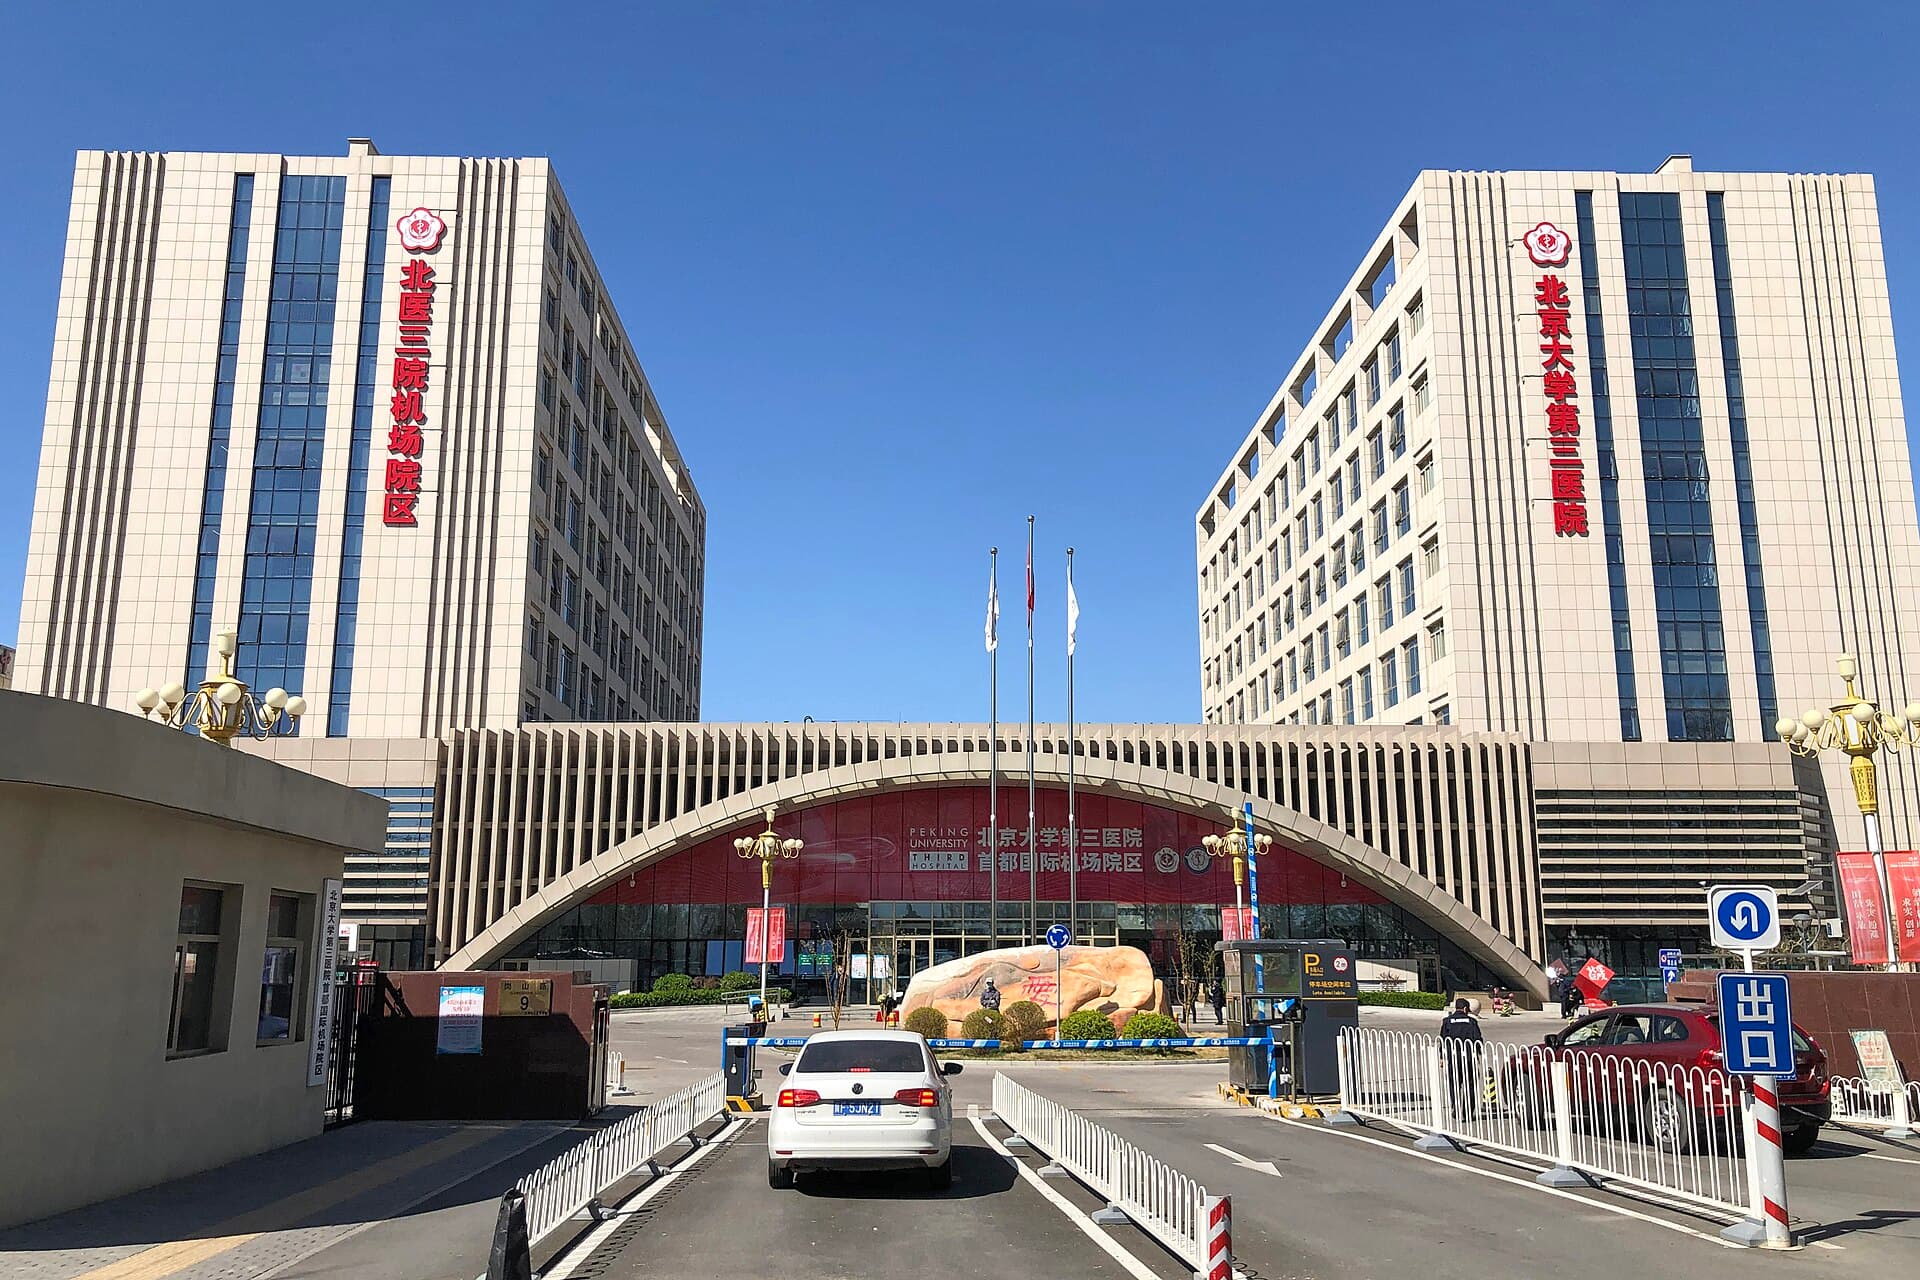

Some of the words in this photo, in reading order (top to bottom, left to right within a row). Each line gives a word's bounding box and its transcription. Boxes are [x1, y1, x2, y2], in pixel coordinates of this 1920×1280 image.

[383, 259, 433, 525] 北医三院机场院区
[1535, 274, 1588, 535] 北京大学第三医院
[910, 827, 969, 837] PEKING
[977, 827, 1143, 848] 北京大学第三医院
[910, 839, 969, 849] UNIVERSITY
[911, 862, 967, 870] HOSPITAL
[912, 853, 966, 861] THIRD
[977, 852, 1143, 872] 首都国际机场院区
[1304, 953, 1320, 974] P
[314, 889, 337, 1076] 北京大学第三医院首都国际机场院区
[520, 995, 529, 1011] 9
[1737, 979, 1777, 1068] 出口
